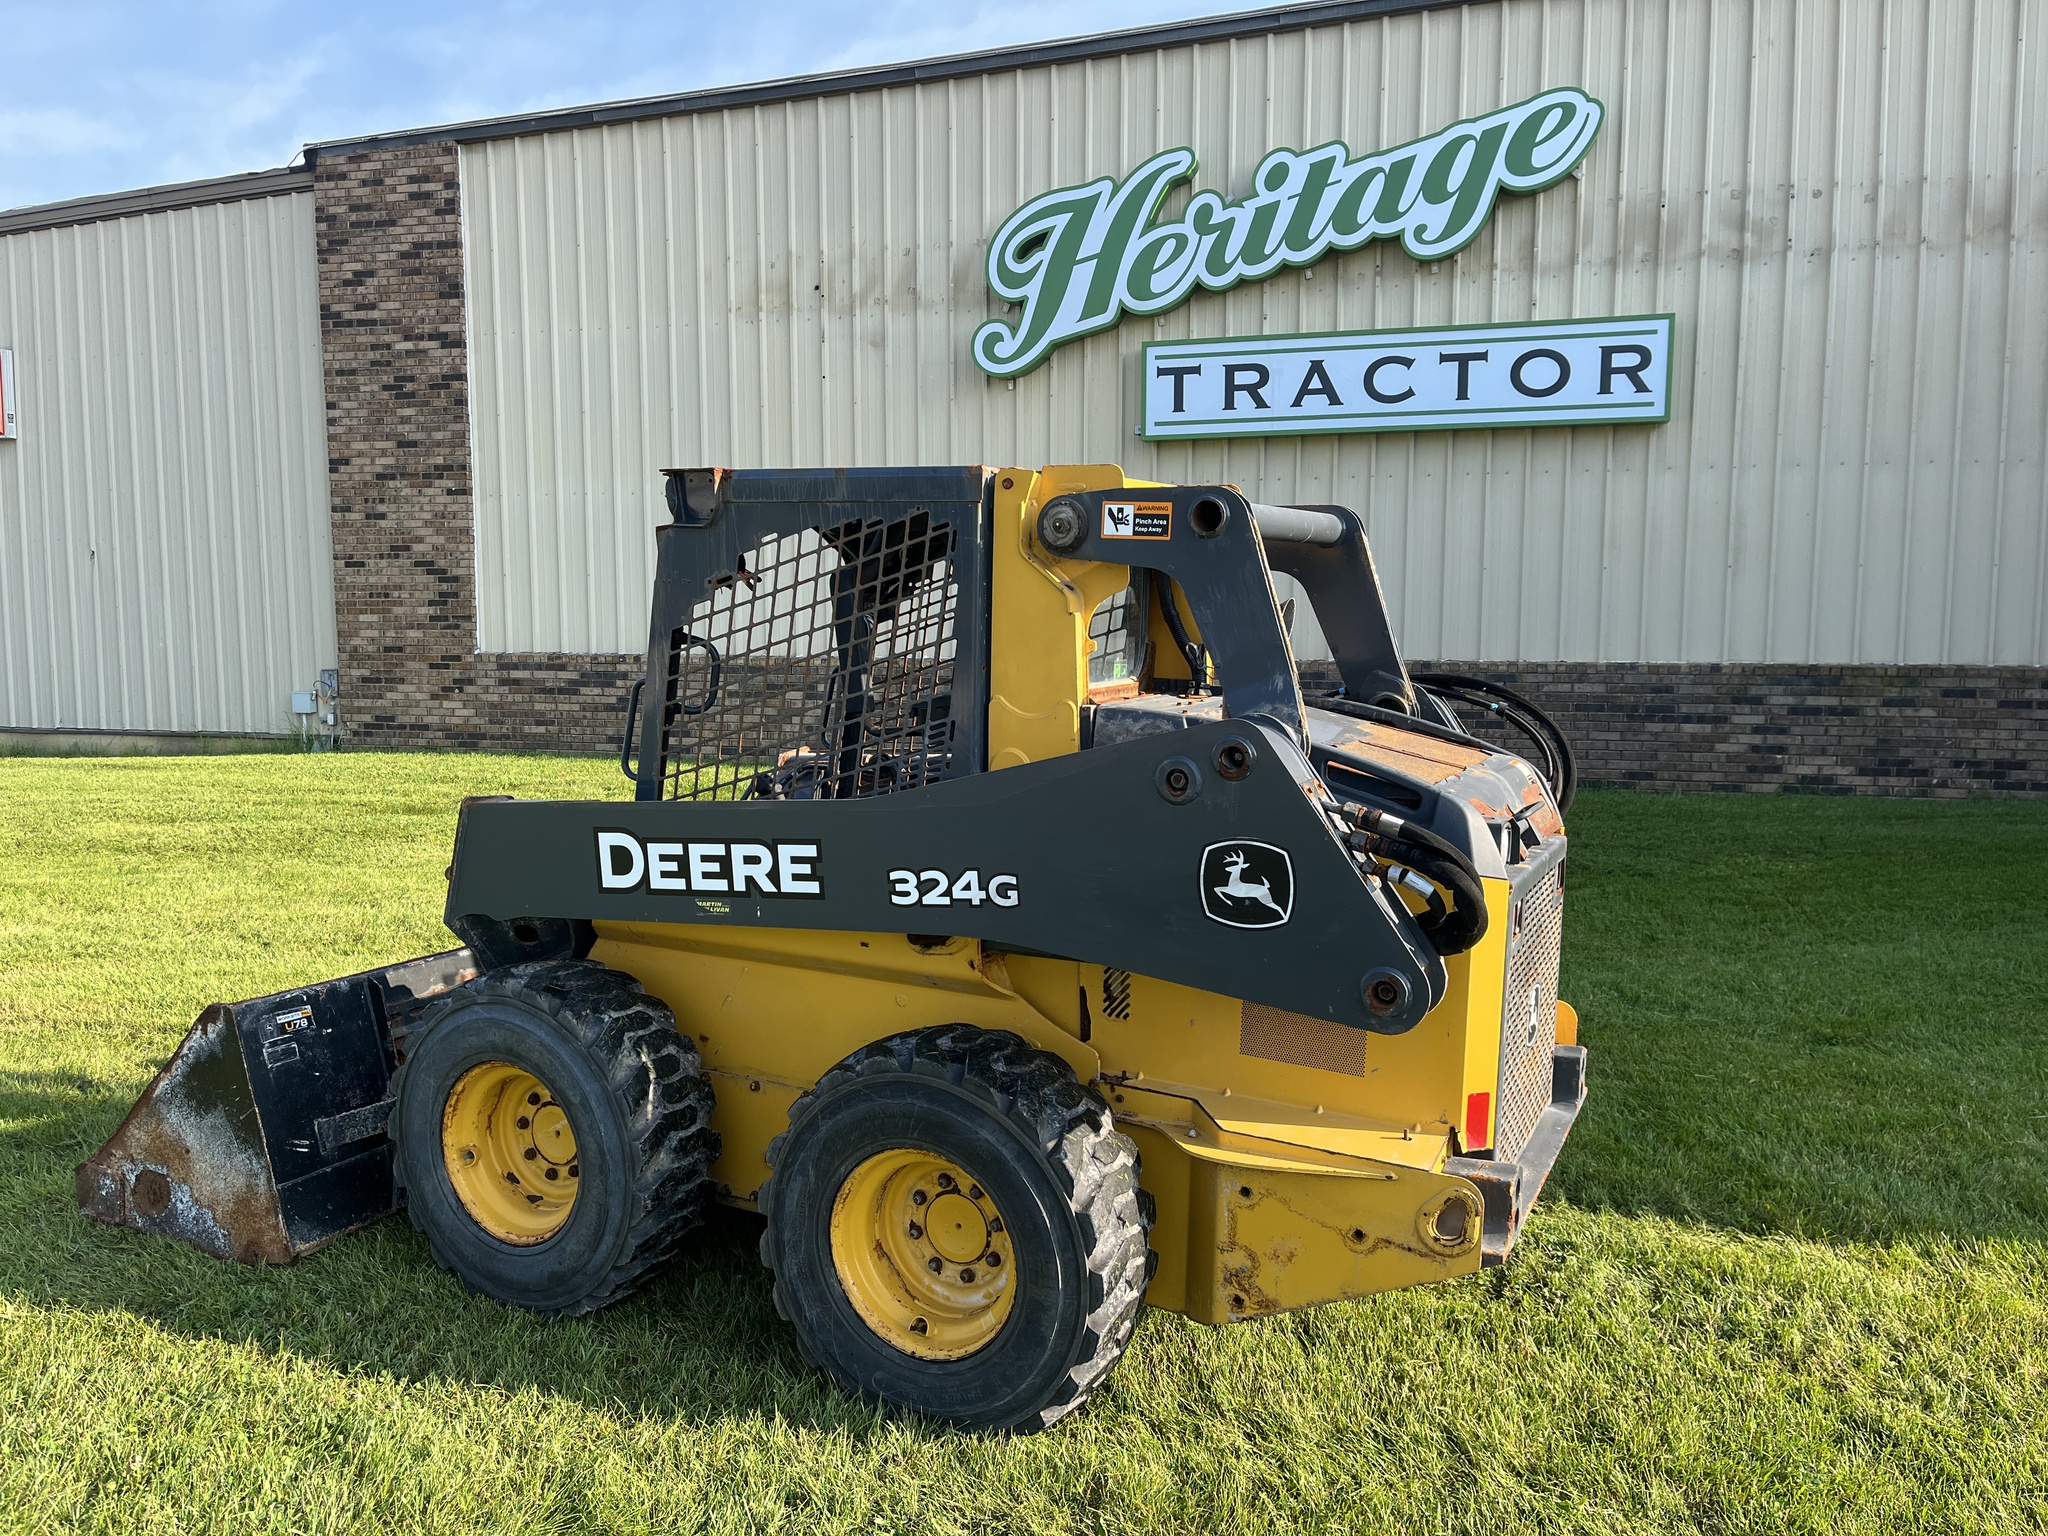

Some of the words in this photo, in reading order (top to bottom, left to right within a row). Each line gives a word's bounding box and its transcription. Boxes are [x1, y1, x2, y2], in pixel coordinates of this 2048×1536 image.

[980, 96, 1594, 362] Heritage
[1157, 343, 1654, 414] TRACTOR
[597, 832, 821, 894] DEERE
[889, 870, 1019, 907] 324G
[285, 1018, 308, 1030] U78
